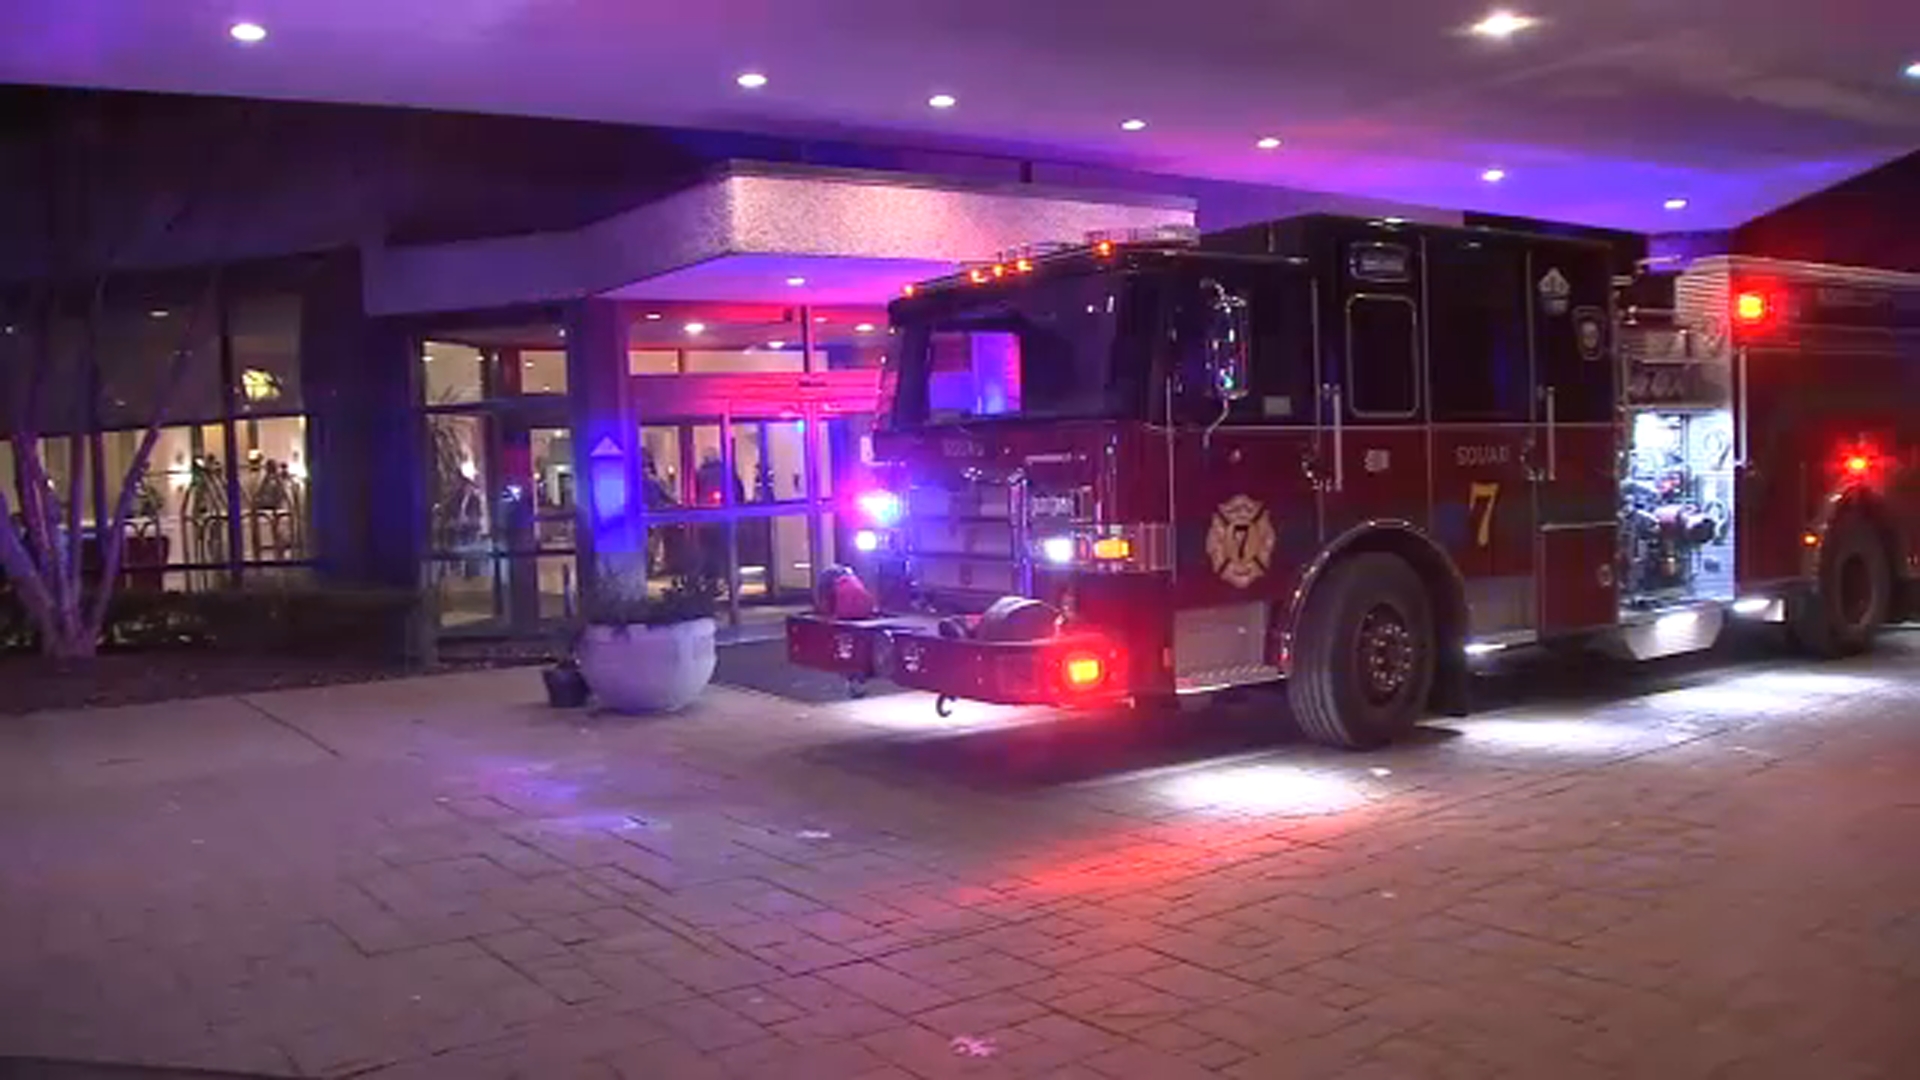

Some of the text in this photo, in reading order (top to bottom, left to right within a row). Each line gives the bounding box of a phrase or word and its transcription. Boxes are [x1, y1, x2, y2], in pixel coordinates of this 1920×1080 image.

[1456, 445, 1510, 466] SQUAD
[1469, 482, 1498, 546] 7
[1233, 525, 1249, 559] 7
